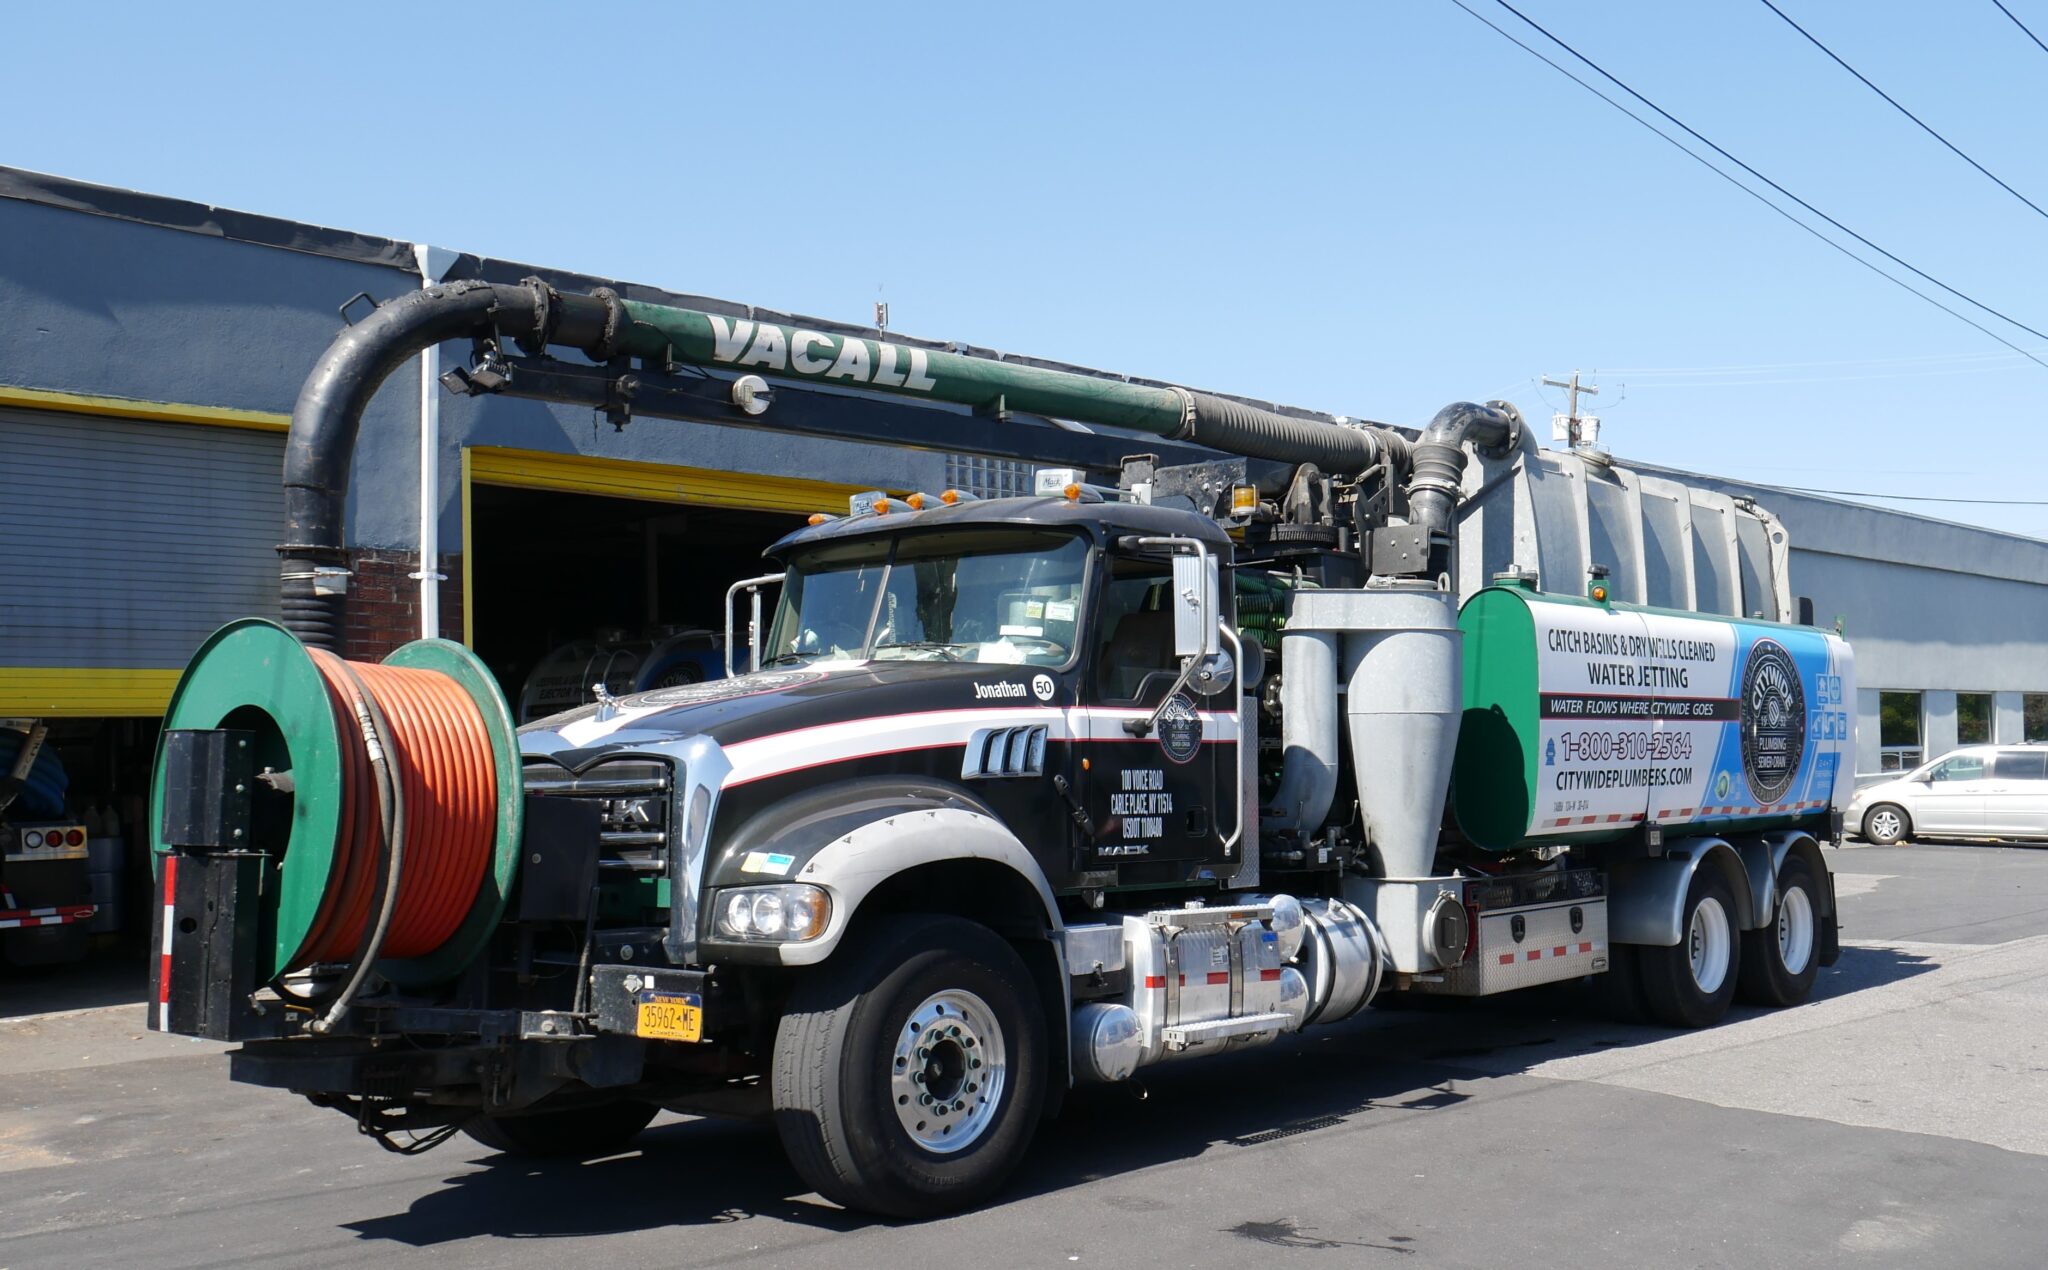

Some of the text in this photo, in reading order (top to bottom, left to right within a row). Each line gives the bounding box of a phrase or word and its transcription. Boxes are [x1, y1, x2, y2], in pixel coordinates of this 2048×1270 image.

[707, 315, 937, 392] VACALL
[1548, 628, 1582, 654] CATCH
[1583, 631, 1619, 656] BASINS
[1620, 634, 1628, 656] &
[1628, 635, 1647, 657] DRY
[1678, 639, 1716, 662] CLEANED
[1587, 662, 1688, 689] WATER JETTING
[973, 680, 1052, 699] Jonathan 50
[1752, 665, 1794, 711] CITYWIDE
[1551, 699, 1713, 716] WATER FLOWS WHERE CITYWIDE GOES
[1561, 731, 1692, 761] 1-800-310-2564
[1759, 737, 1786, 750] PLUMBING
[1121, 769, 1164, 791] 100 VOICE ROAD
[1555, 767, 1693, 791] CITYWIDEPLUMBERS.COM
[1110, 792, 1173, 816] CARLE PLACE, NY 11514
[1122, 817, 1140, 839] USDOT
[1098, 844, 1150, 857] MACK
[644, 1005, 695, 1032] 35962 ME
